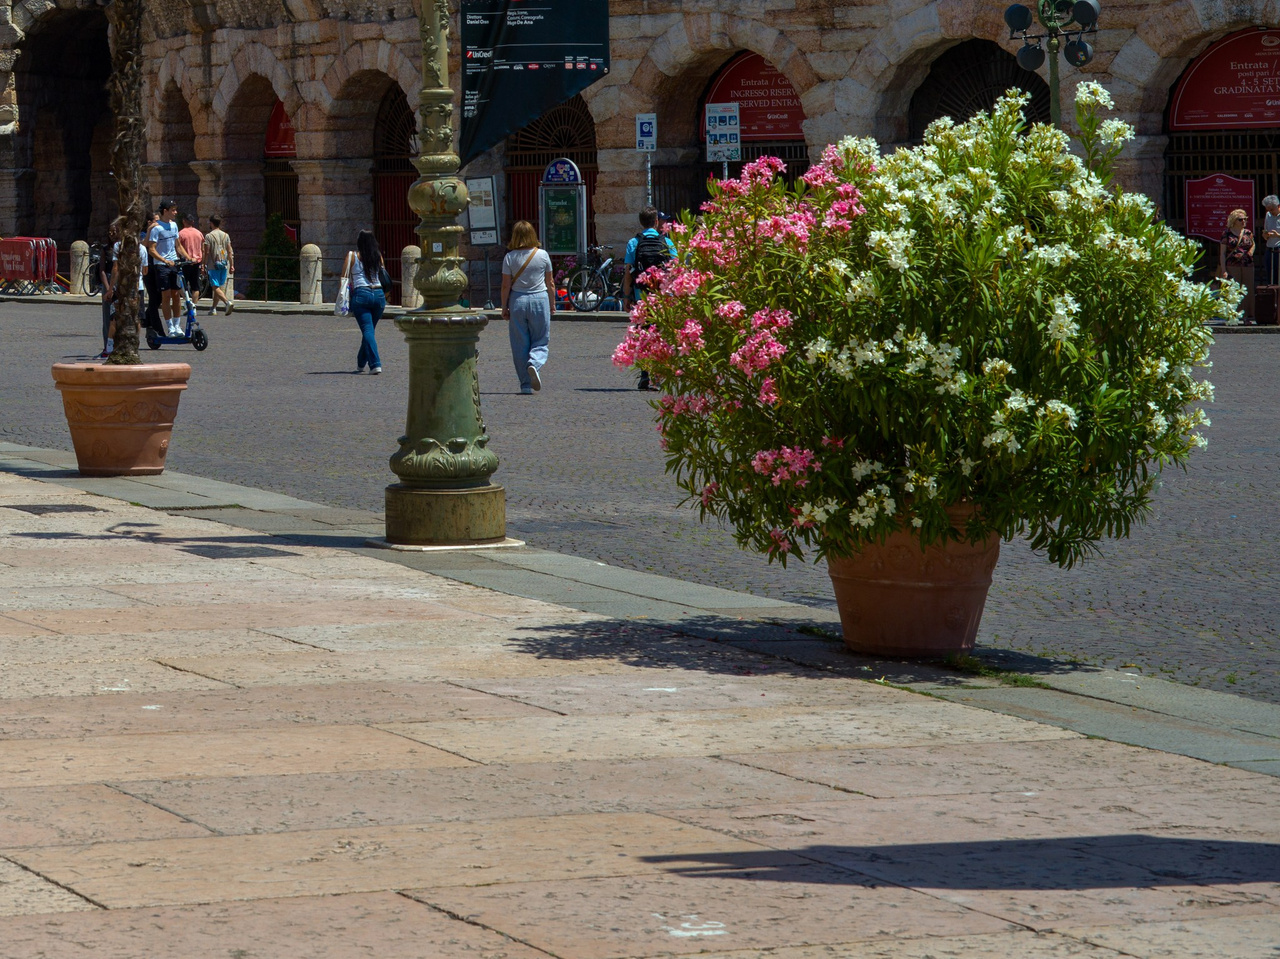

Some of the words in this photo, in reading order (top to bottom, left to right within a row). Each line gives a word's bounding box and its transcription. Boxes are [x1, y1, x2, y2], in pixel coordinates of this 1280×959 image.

[1230, 61, 1269, 70] Entrata
[1237, 71, 1254, 79] posti
[1256, 71, 1270, 79] pari
[741, 78, 769, 86] Entrata
[1253, 78, 1259, 86] 5
[730, 89, 769, 98] INGRESSO
[1214, 85, 1274, 95] GRADINATA
